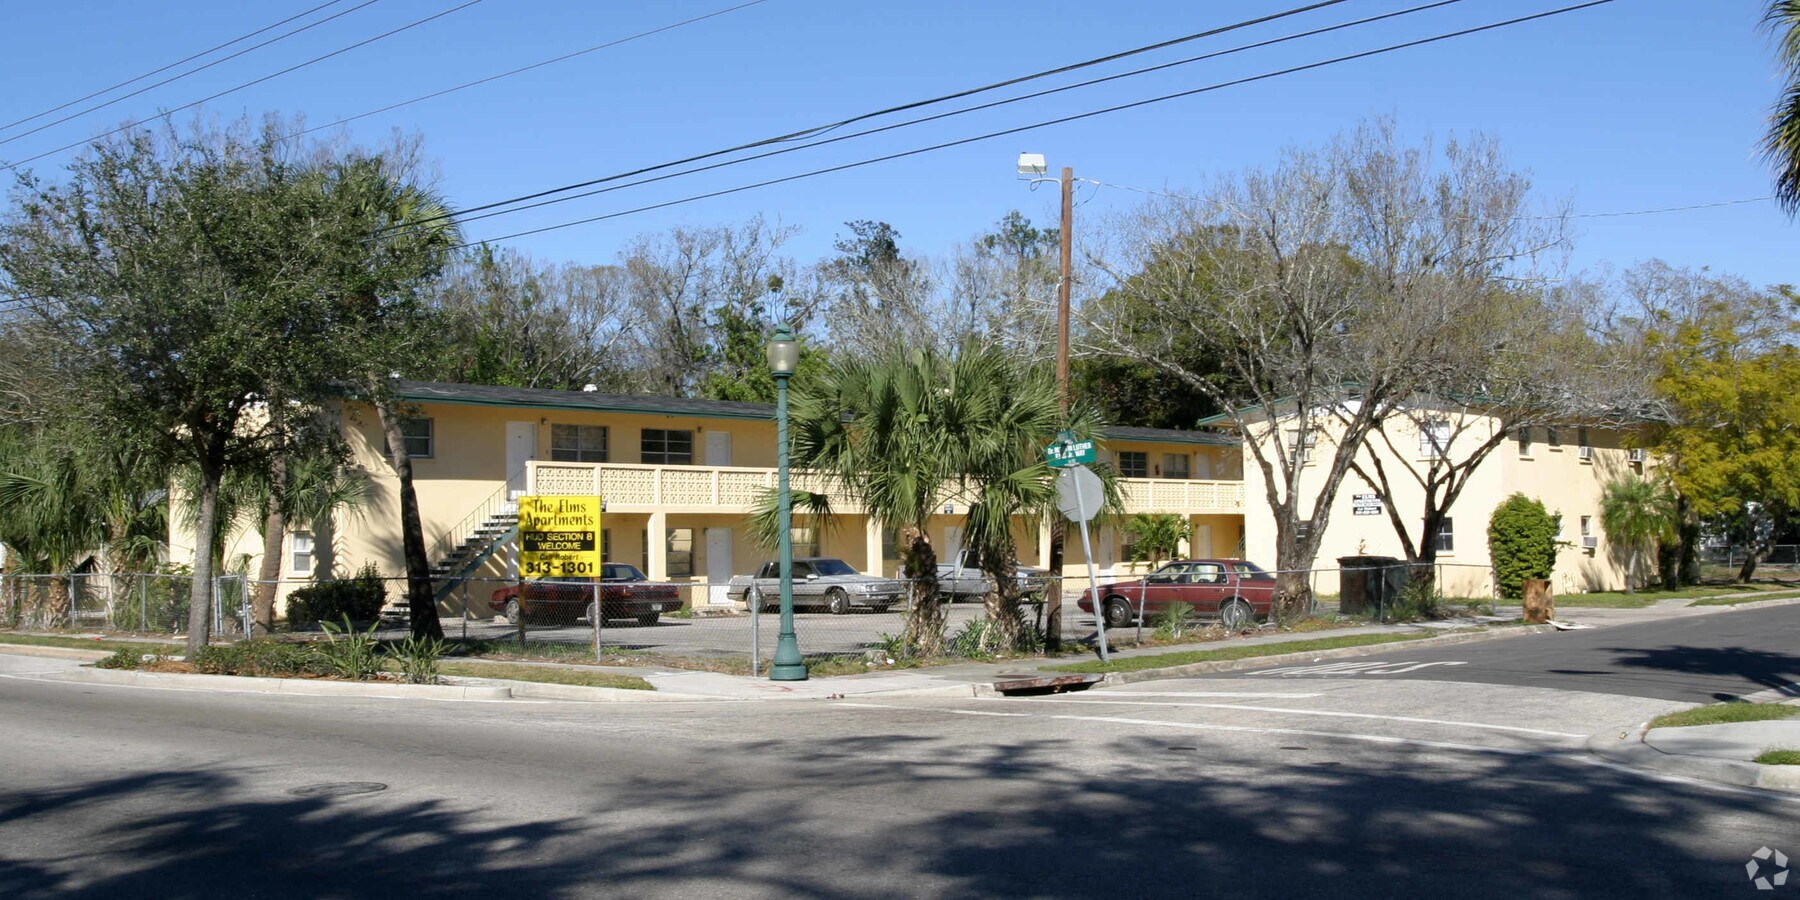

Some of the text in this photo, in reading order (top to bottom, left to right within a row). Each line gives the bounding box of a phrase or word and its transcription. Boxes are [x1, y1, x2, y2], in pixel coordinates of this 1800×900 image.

[1054, 445, 1073, 454] MAIN
[1074, 442, 1092, 451] LUTHER
[533, 499, 553, 513] The
[559, 499, 587, 513] Elms
[526, 512, 594, 529] Apartments
[525, 532, 593, 541] HUD SECTION 8
[537, 541, 582, 550] WELCOME
[555, 553, 579, 561] Robert
[526, 561, 593, 574] 313-1301
